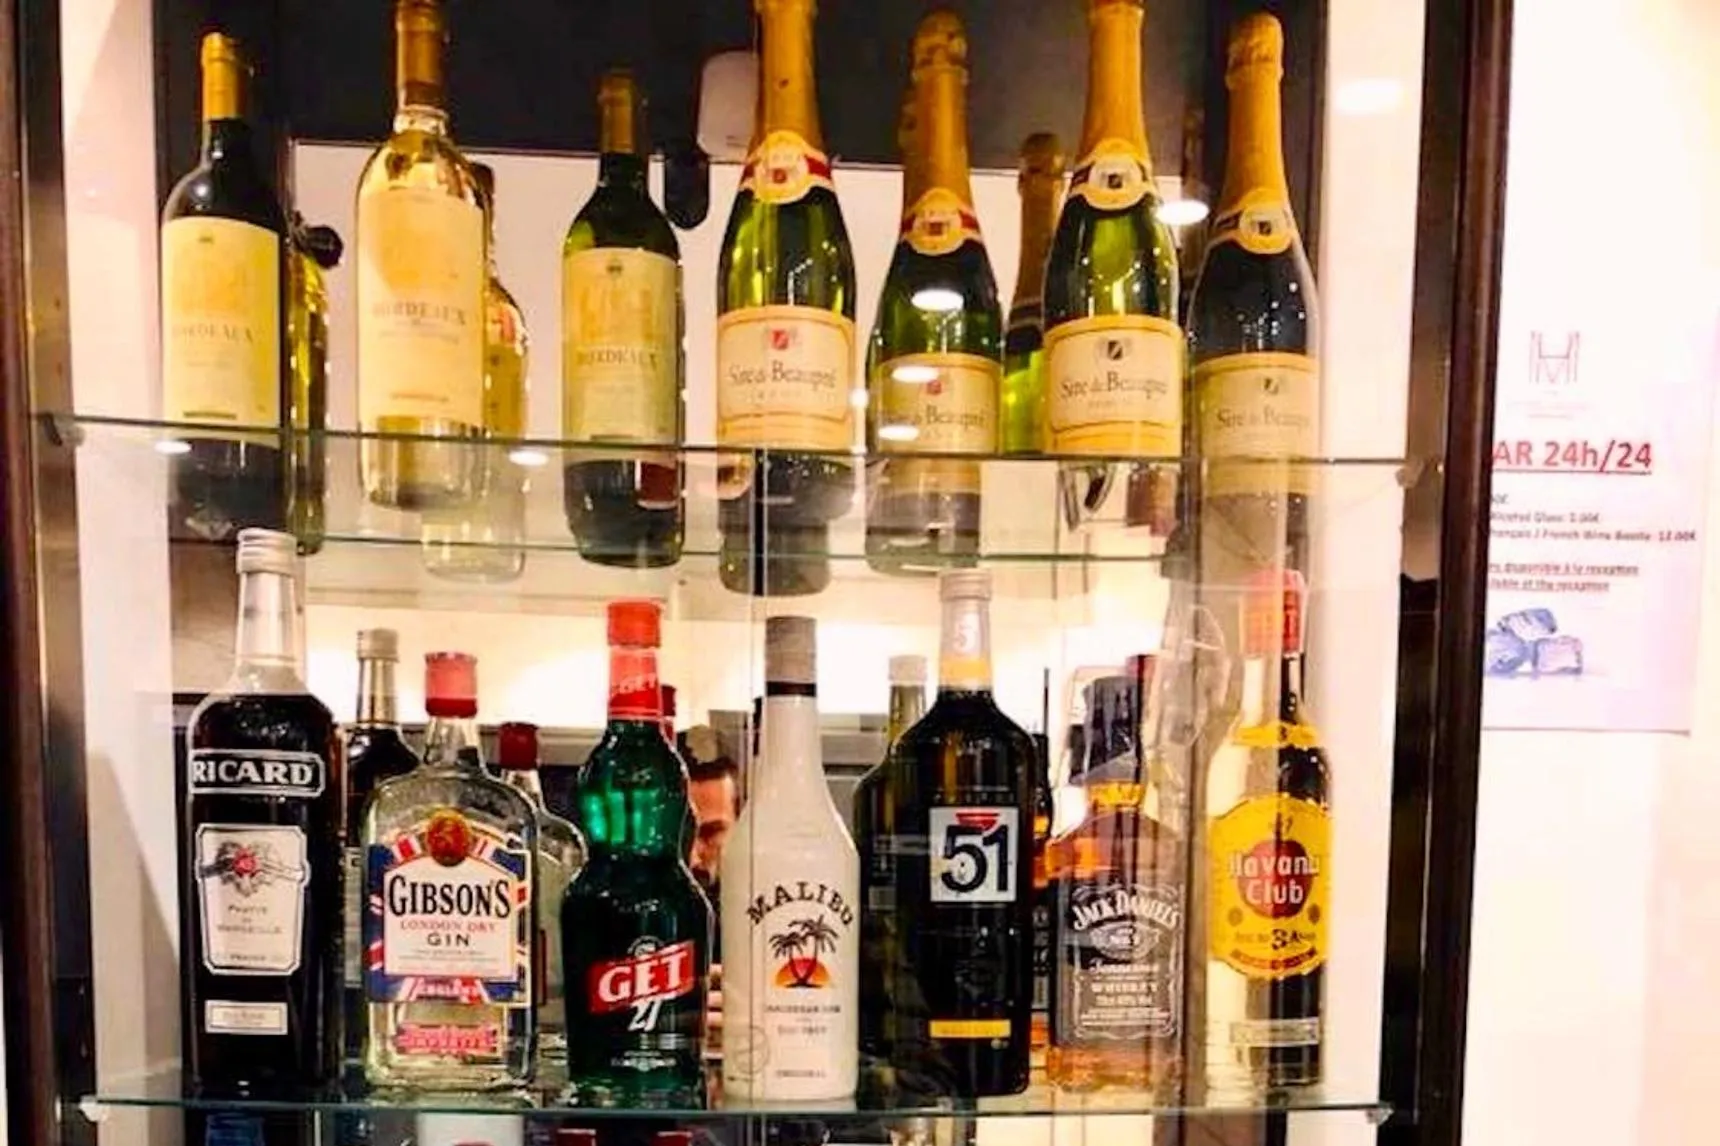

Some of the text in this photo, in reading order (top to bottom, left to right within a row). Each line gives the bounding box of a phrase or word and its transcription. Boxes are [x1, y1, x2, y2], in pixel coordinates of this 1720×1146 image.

[1543, 439, 1653, 473] 24h/24
[192, 760, 313, 785] RICARD
[941, 823, 1009, 893] 51
[388, 874, 512, 919] GIBSON'S
[746, 881, 854, 926] MALIBU
[1245, 878, 1304, 904] Club
[400, 919, 464, 932] LONDON
[427, 931, 471, 947] GIN
[598, 950, 689, 1003] GET
